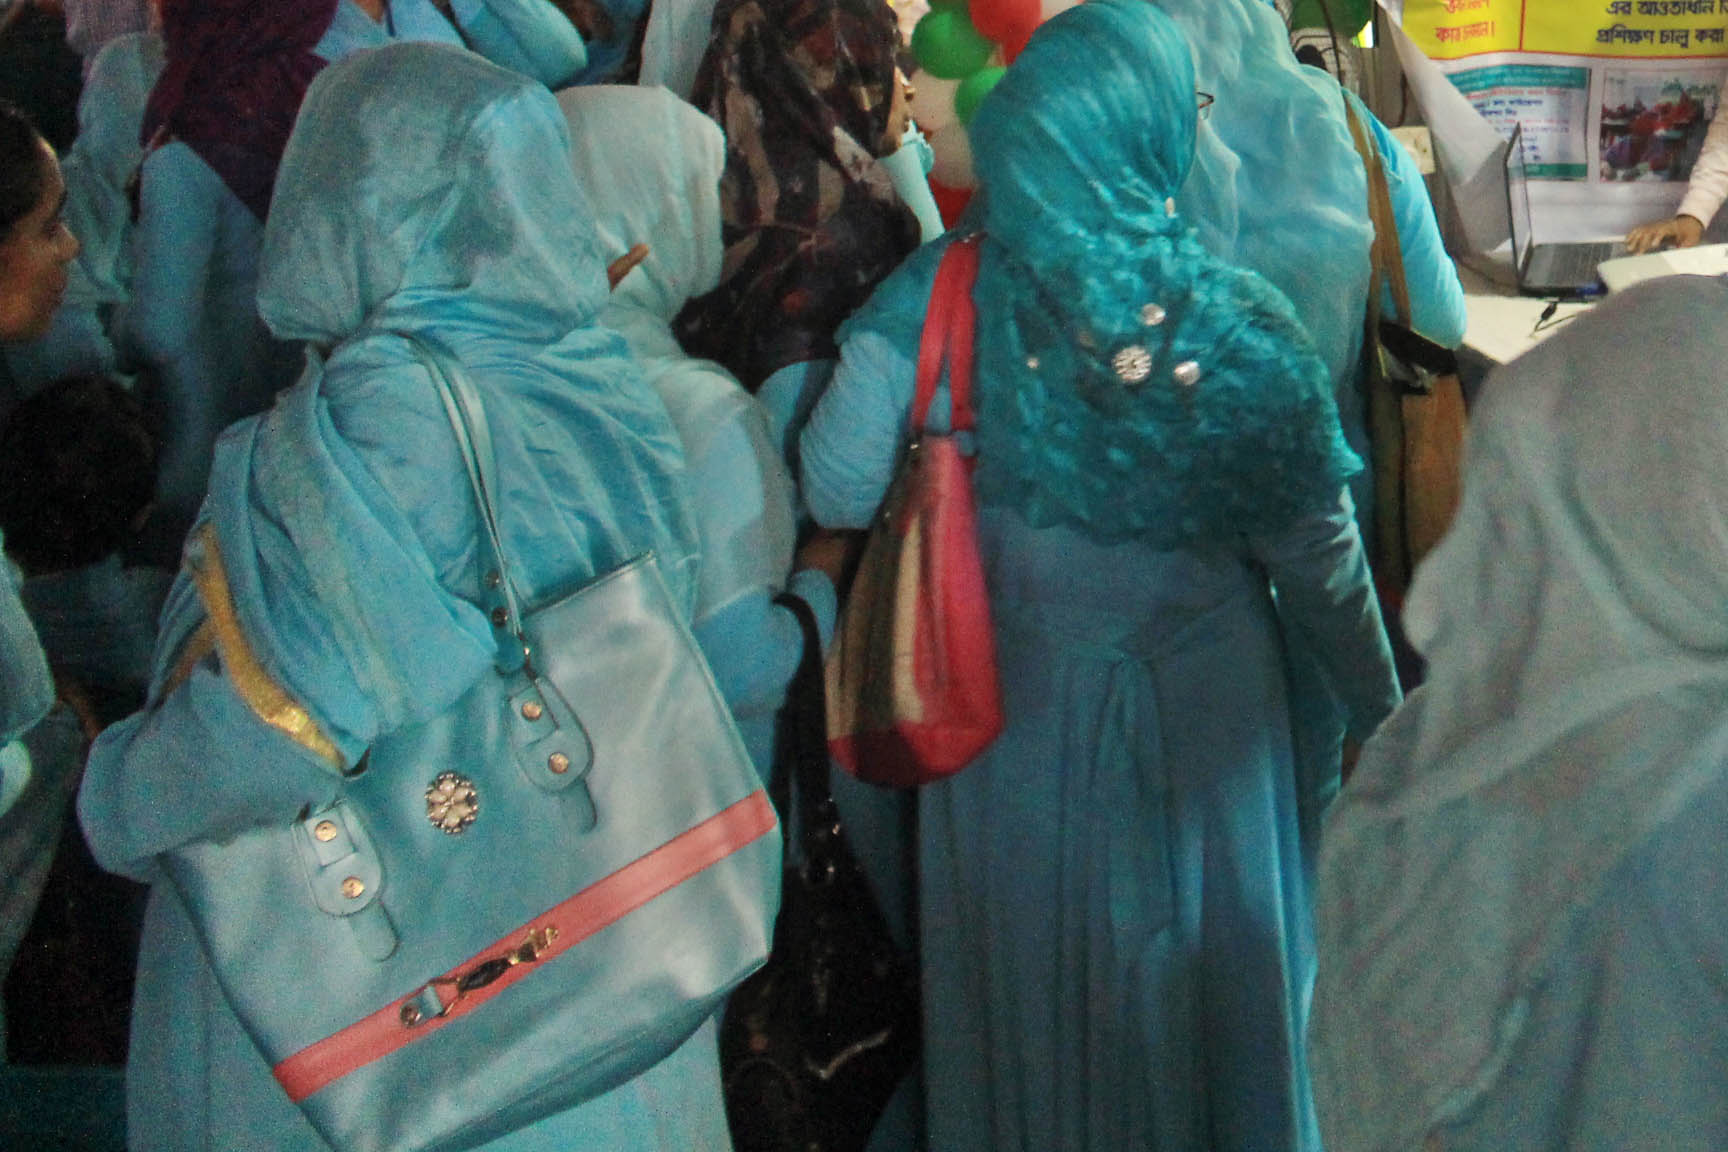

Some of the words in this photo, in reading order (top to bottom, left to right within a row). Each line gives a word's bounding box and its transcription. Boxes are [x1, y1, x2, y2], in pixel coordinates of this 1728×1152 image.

[1605, 0, 1632, 16] এর
[1595, 24, 1655, 44] প্রশিক্ষণ
[1659, 28, 1690, 48] চালু
[1694, 28, 1724, 43] করা
